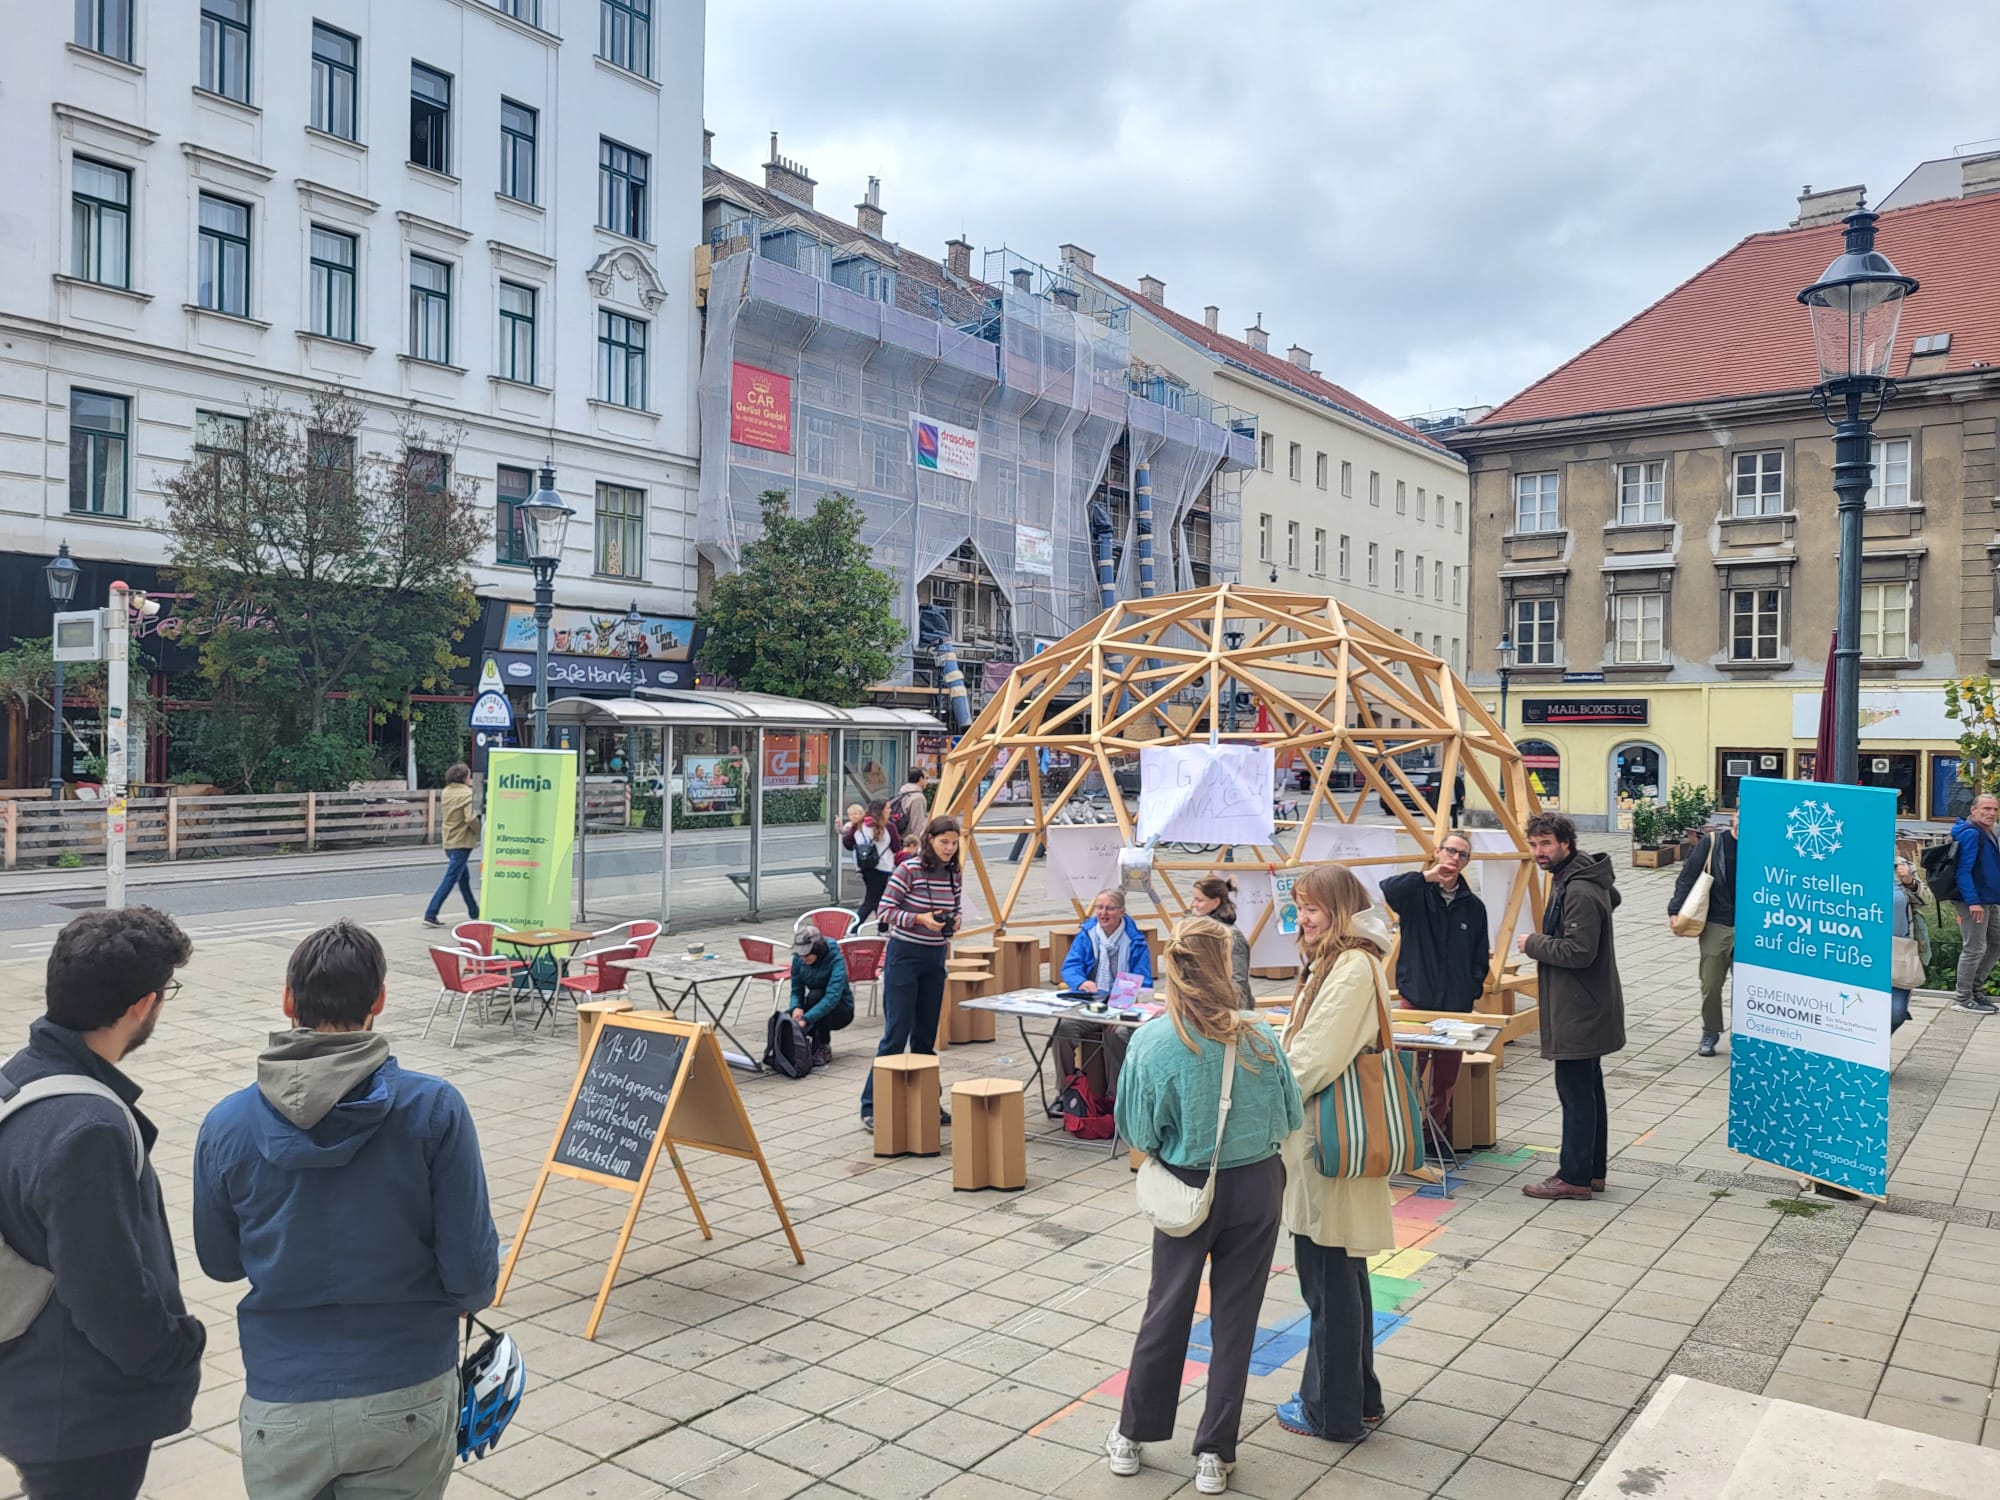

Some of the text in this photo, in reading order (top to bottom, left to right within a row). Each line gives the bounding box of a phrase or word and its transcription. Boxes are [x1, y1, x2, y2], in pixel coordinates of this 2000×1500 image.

[747, 391, 775, 409] CAR
[763, 408, 787, 423] GmbH
[651, 624, 663, 636] LET
[656, 631, 673, 644] LOVE
[661, 639, 679, 652] RULE
[588, 663, 648, 685] Harvet
[1547, 704, 1642, 714] MAIL BOXES ETC.
[498, 773, 552, 793] klimja
[1144, 758, 1270, 793] DGOWH
[1764, 865, 1864, 897] Wir stellen
[1752, 886, 1884, 924] die Wirtschaft
[1762, 908, 1864, 940] vom Kopf
[1754, 933, 1873, 968] auf die Füße
[1746, 984, 1837, 1014] GEMEINWOHL
[1746, 998, 1822, 1026] ÖKONOMIE
[1745, 1016, 1803, 1042] Österreich
[605, 1032, 648, 1065] 14:00
[566, 1134, 632, 1177] Wachstum
[619, 1135, 639, 1152] von
[1812, 1148, 1877, 1176] ecogood.org
